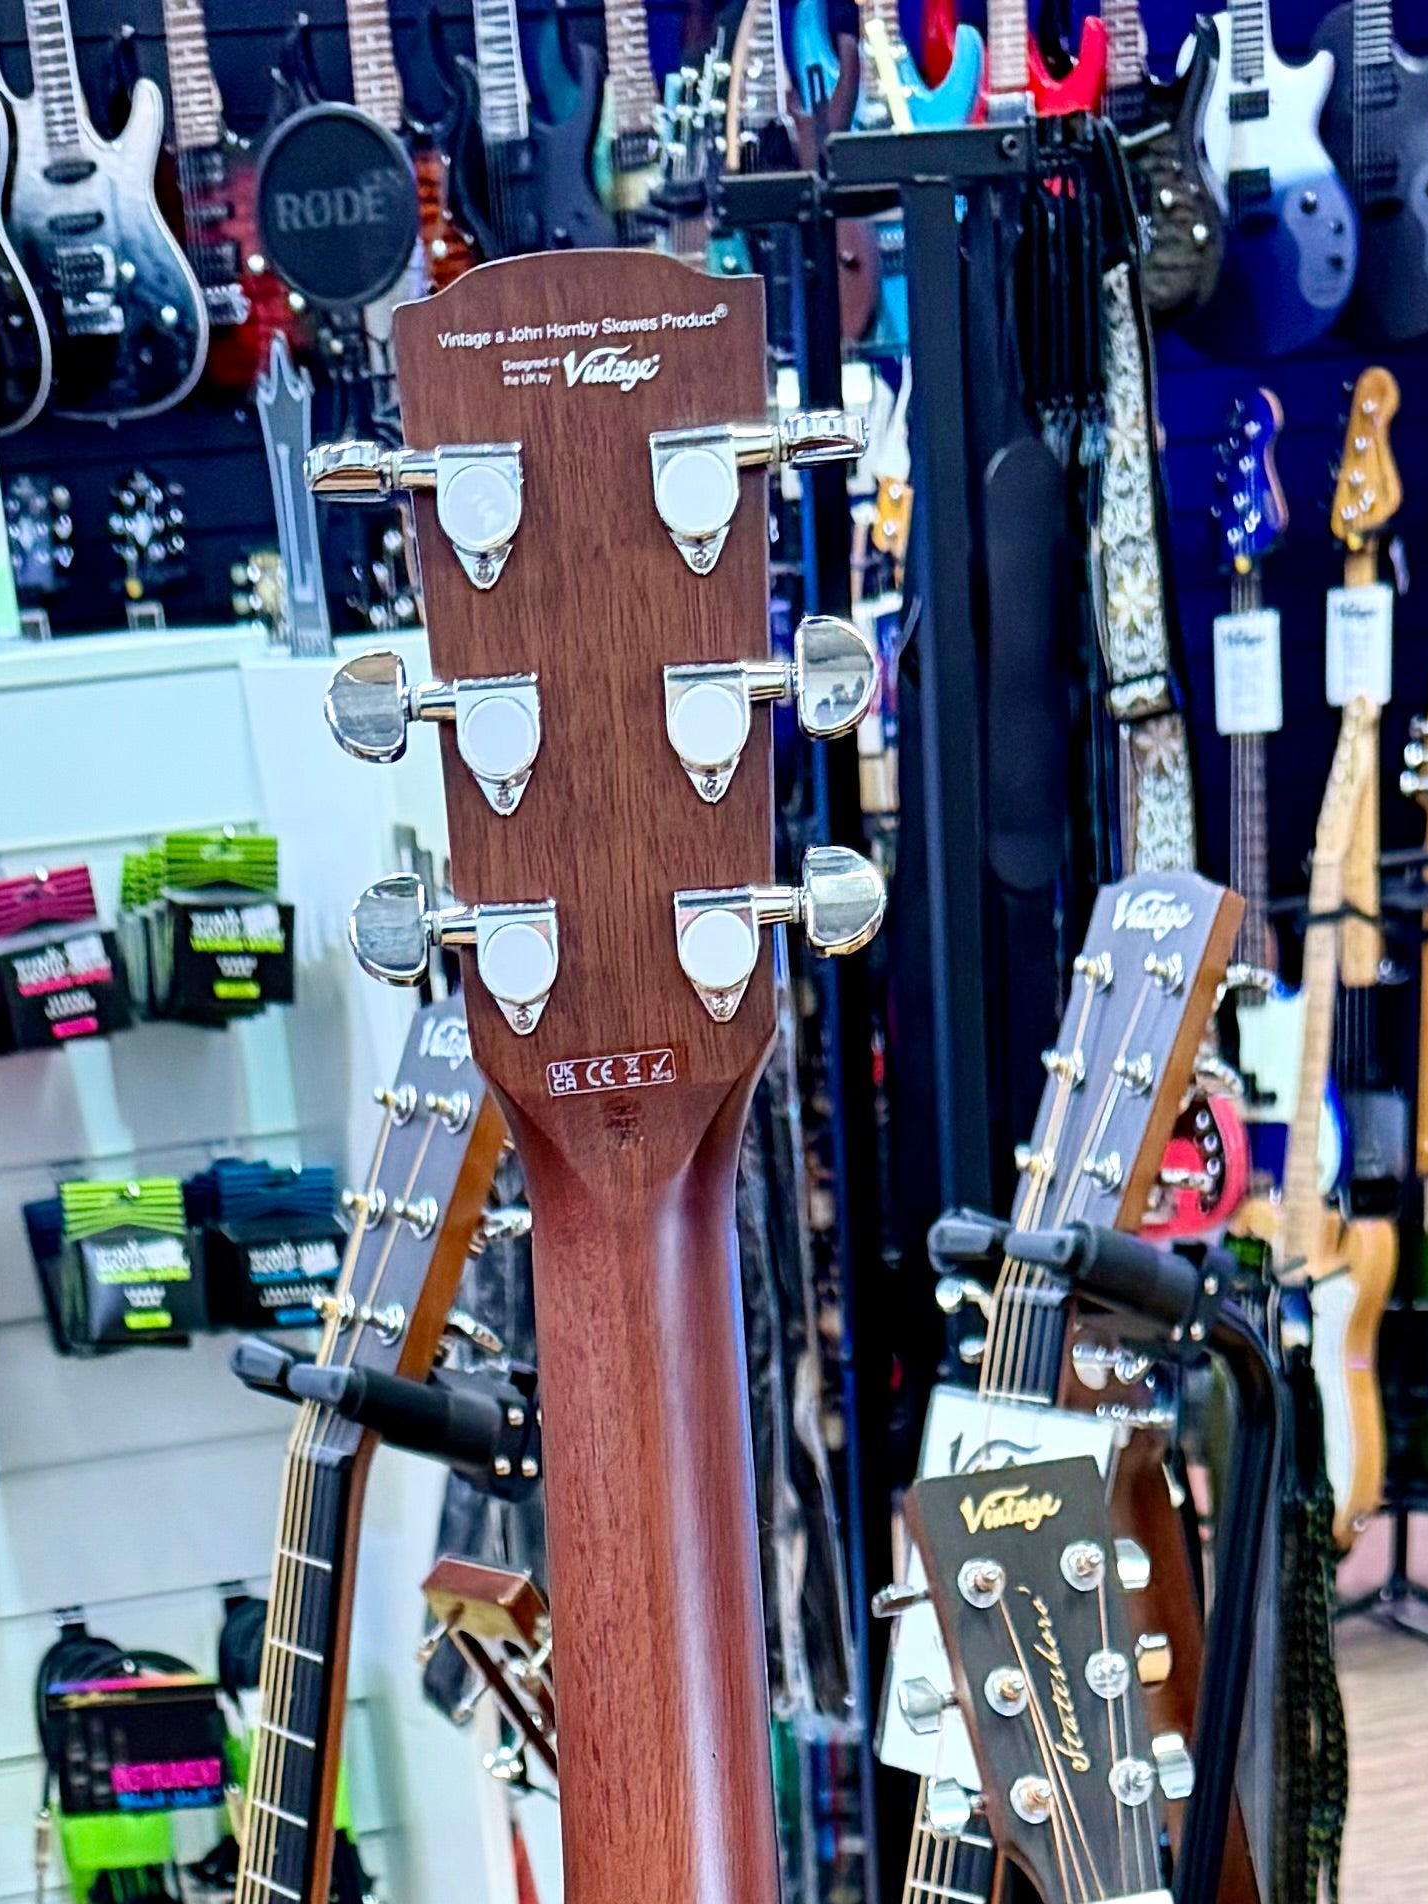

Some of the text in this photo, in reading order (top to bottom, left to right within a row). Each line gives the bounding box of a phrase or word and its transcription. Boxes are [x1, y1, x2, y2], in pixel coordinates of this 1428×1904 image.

[438, 331, 491, 350] Vintage
[507, 324, 542, 344] John
[546, 320, 598, 341] Hornby
[601, 314, 658, 335] Skewes
[563, 344, 661, 392] Vintage
[960, 1485, 1061, 1533] Vintage
